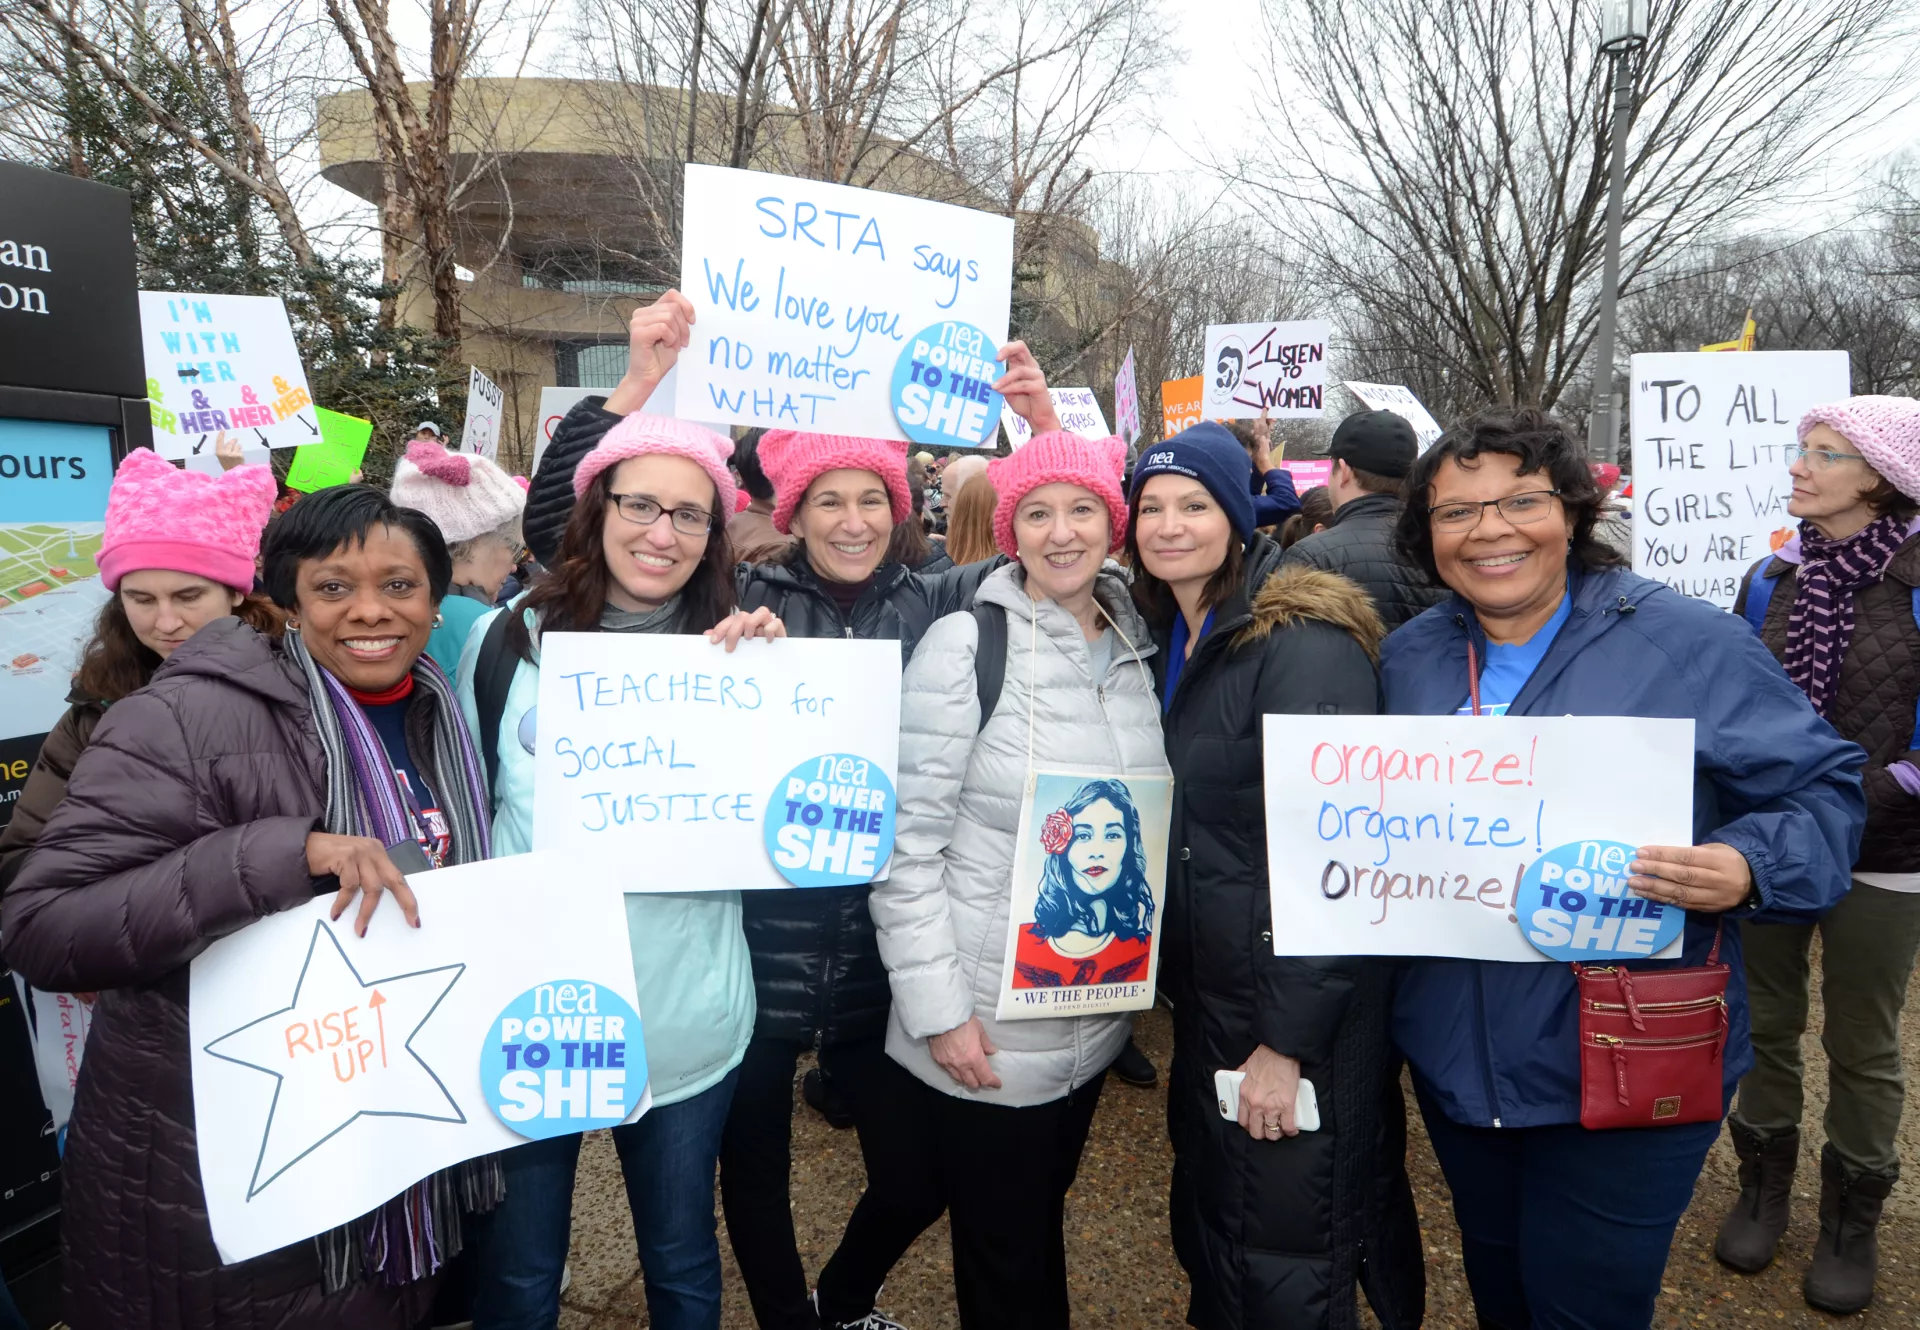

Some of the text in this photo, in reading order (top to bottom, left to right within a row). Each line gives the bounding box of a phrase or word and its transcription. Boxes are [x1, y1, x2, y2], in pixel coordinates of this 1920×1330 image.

[756, 197, 979, 308] SRTA says
[168, 298, 213, 323] I'M
[704, 257, 903, 358] We love you
[160, 332, 241, 354] WITH
[938, 321, 983, 358] nea
[1264, 341, 1323, 365] LISTEN
[176, 360, 237, 385] HER
[709, 336, 870, 391] no matter
[911, 339, 996, 383] POWER
[1282, 365, 1302, 379] TO
[473, 370, 502, 410] PUSSY
[910, 361, 993, 404] TO THE
[1258, 377, 1322, 409] WOMEN
[1355, 386, 1413, 405] WORDS
[150, 403, 177, 435] ER
[228, 405, 276, 429] HER
[272, 386, 314, 422] HER
[708, 382, 836, 425] WHAT
[897, 383, 989, 443] SHE
[1165, 401, 1201, 415] WE AR
[1726, 384, 1789, 426] ALL
[179, 409, 231, 435] HER
[1061, 413, 1096, 431] GRABS
[1148, 451, 1175, 465] nea
[1645, 437, 1706, 471] THE
[1645, 487, 1733, 526] GIRLS
[1645, 532, 1755, 567] YOU ARE
[560, 671, 834, 716] TEACHERS for
[555, 736, 695, 777] SOCIAL
[815, 754, 869, 787] nea
[581, 791, 755, 831] JUSTICE
[786, 777, 887, 811] POWER
[785, 800, 884, 834] TO THE
[774, 825, 881, 877] SHE
[1538, 884, 1663, 919] TO THE
[1529, 909, 1661, 955] SHE
[532, 982, 598, 1015] nea
[1024, 985, 1139, 1005] WE THE PEOPLE
[285, 1005, 360, 1058] RISE
[501, 1016, 626, 1042] POWER
[332, 1039, 374, 1083] UP
[501, 1041, 626, 1070] TO THE
[498, 1068, 627, 1122] SHE
